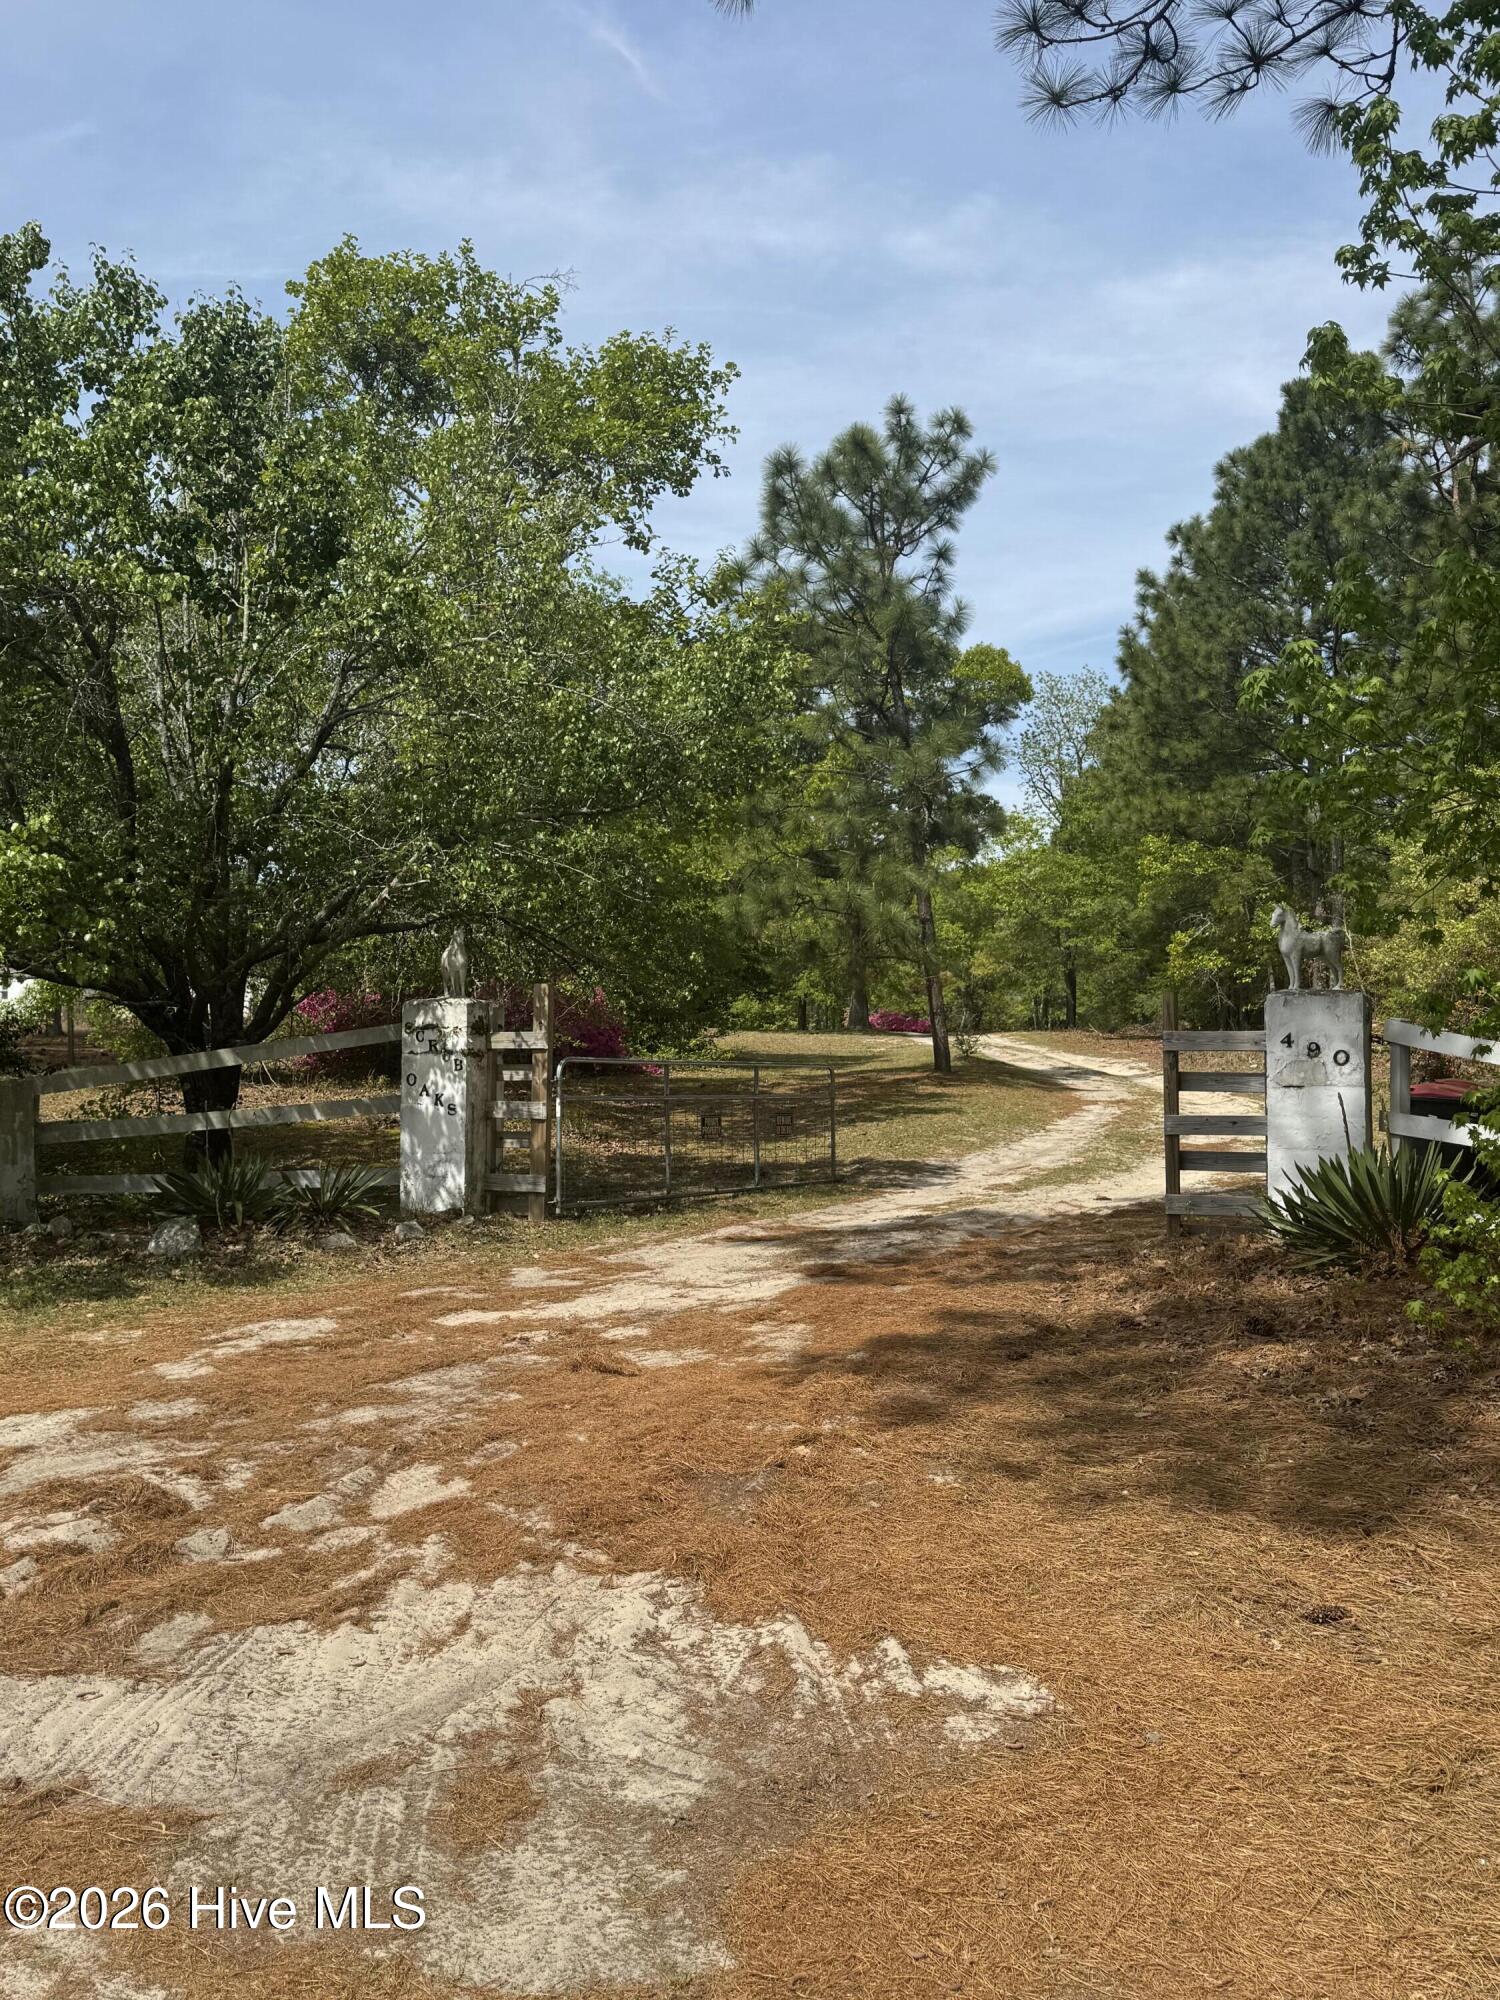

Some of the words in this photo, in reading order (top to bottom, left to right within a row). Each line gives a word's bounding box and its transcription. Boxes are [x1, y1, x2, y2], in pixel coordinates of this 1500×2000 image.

[404, 1022, 463, 1071] SCRUB
[1280, 1032, 1350, 1067] 490
[406, 1073, 457, 1116] OAKS
